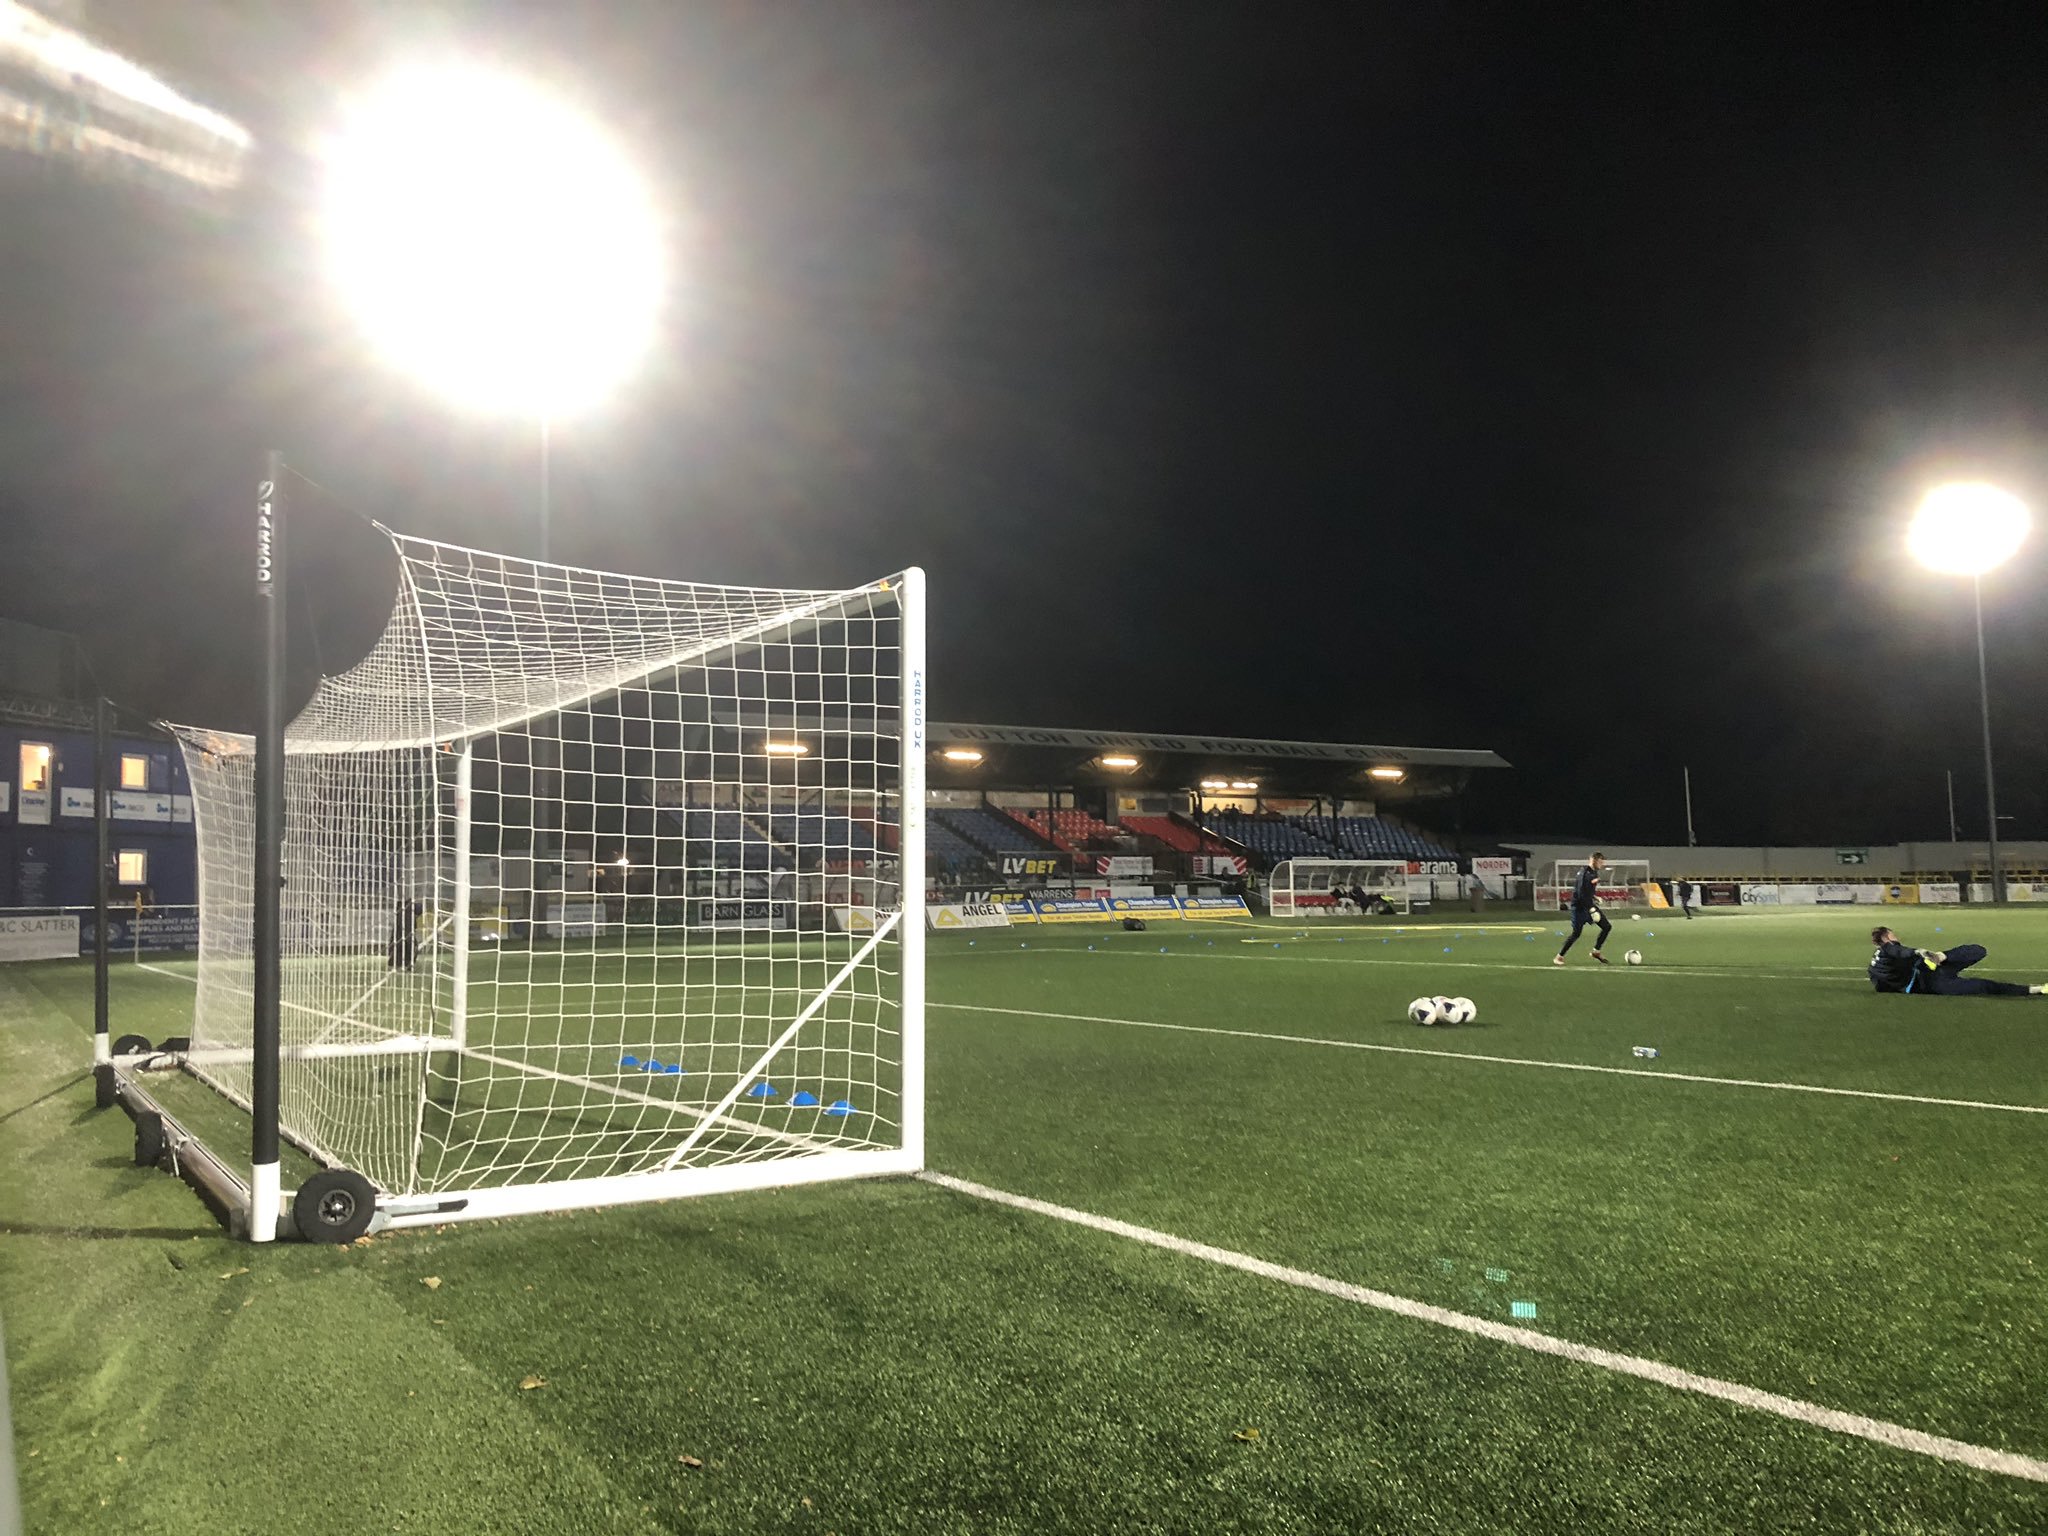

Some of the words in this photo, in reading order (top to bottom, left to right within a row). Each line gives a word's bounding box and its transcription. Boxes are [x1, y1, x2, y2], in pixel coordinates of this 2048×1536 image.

[950, 728, 1071, 745] SUTTON
[1086, 735, 1186, 750] UNITED
[1200, 741, 1332, 758] FOOTBALL
[1476, 860, 1509, 870] NORDEN
[1029, 889, 1074, 899] WARRENS
[704, 905, 739, 919] BARN
[743, 904, 781, 917] GLASS
[962, 904, 1001, 916] ANGEL
[20, 919, 76, 933] SLATTER
